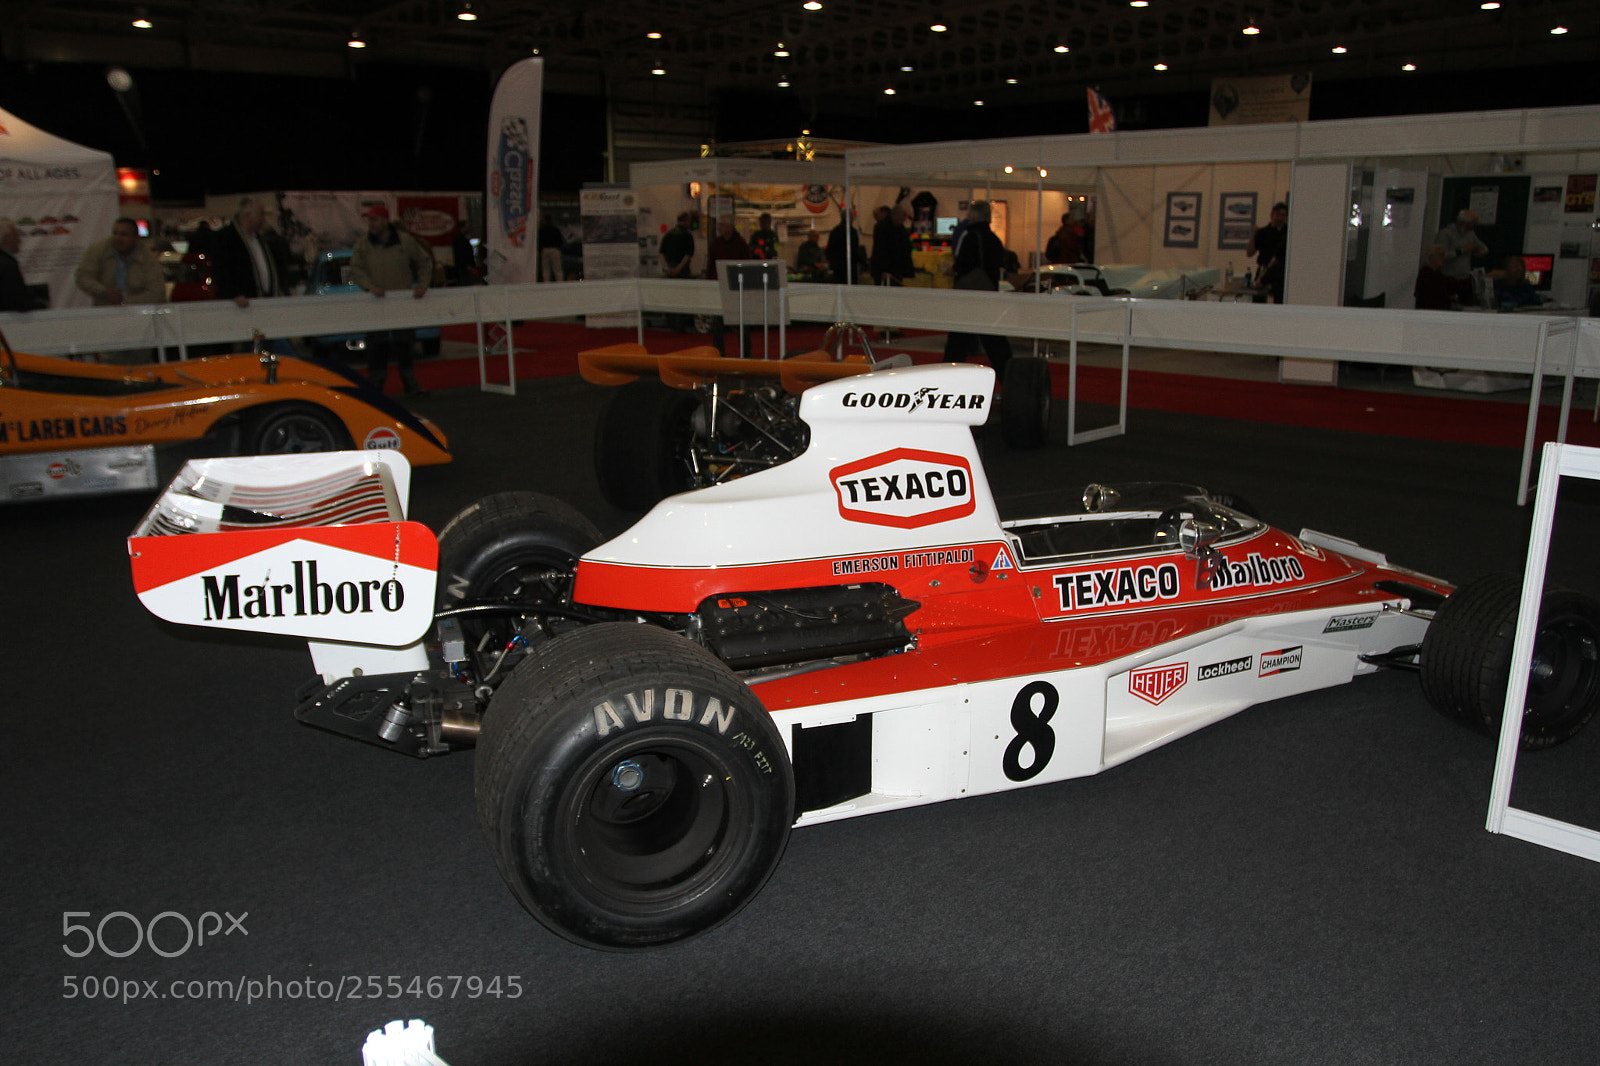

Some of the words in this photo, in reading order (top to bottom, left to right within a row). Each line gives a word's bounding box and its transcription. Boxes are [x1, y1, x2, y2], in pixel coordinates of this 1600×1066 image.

[80, 415, 127, 438] CARS
[840, 469, 967, 503] TEXACO
[833, 556, 899, 575] EMERSON
[904, 548, 974, 568] FITTIPALDI
[1210, 552, 1305, 591] Marlboro
[202, 560, 405, 621] Marlboro
[1054, 564, 1179, 611] TEXACO
[1328, 615, 1376, 628] Masters
[1198, 657, 1252, 681] Lockheed
[1261, 654, 1301, 670] CHAMPION
[1135, 669, 1183, 699] HEUER
[593, 689, 736, 736] AVON
[1003, 681, 1059, 782] 8
